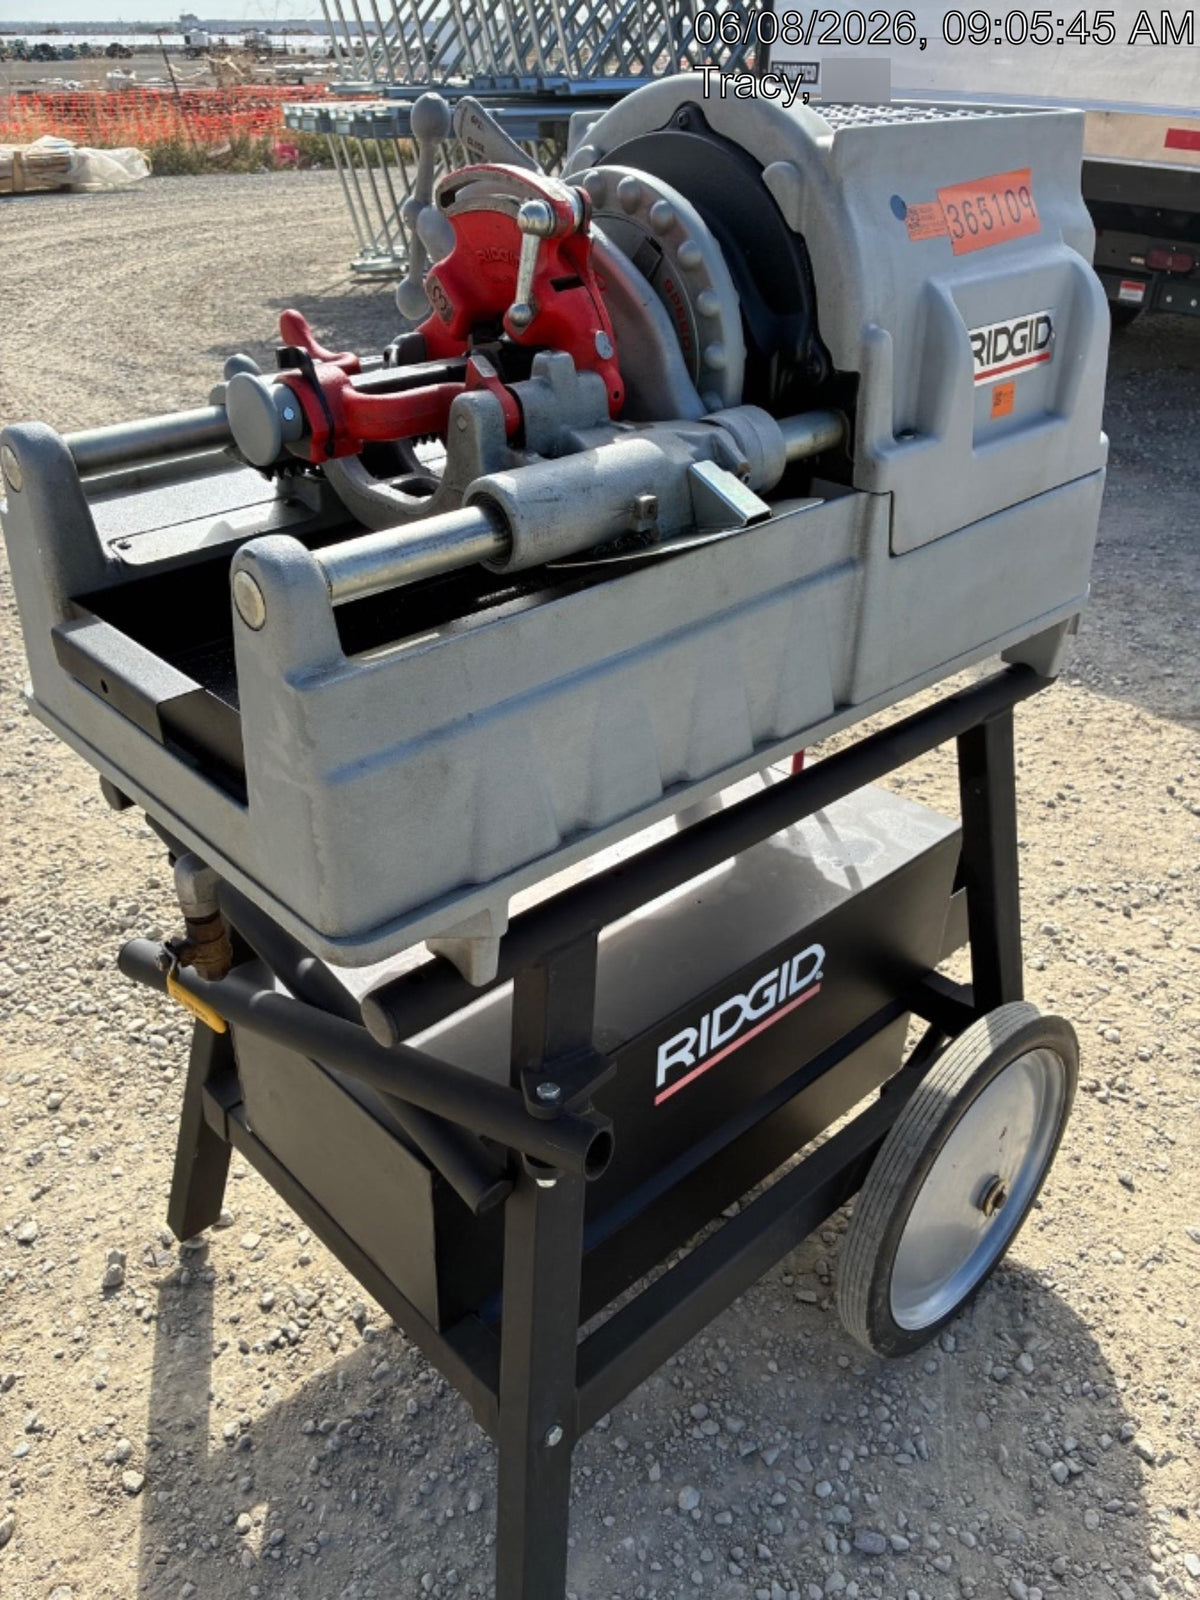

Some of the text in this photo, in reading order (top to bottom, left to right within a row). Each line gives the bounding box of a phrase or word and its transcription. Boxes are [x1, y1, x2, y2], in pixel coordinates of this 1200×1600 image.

[946, 186, 1036, 239] 365109
[969, 315, 1052, 367] RIDGID
[656, 943, 826, 1088] RIDGID
